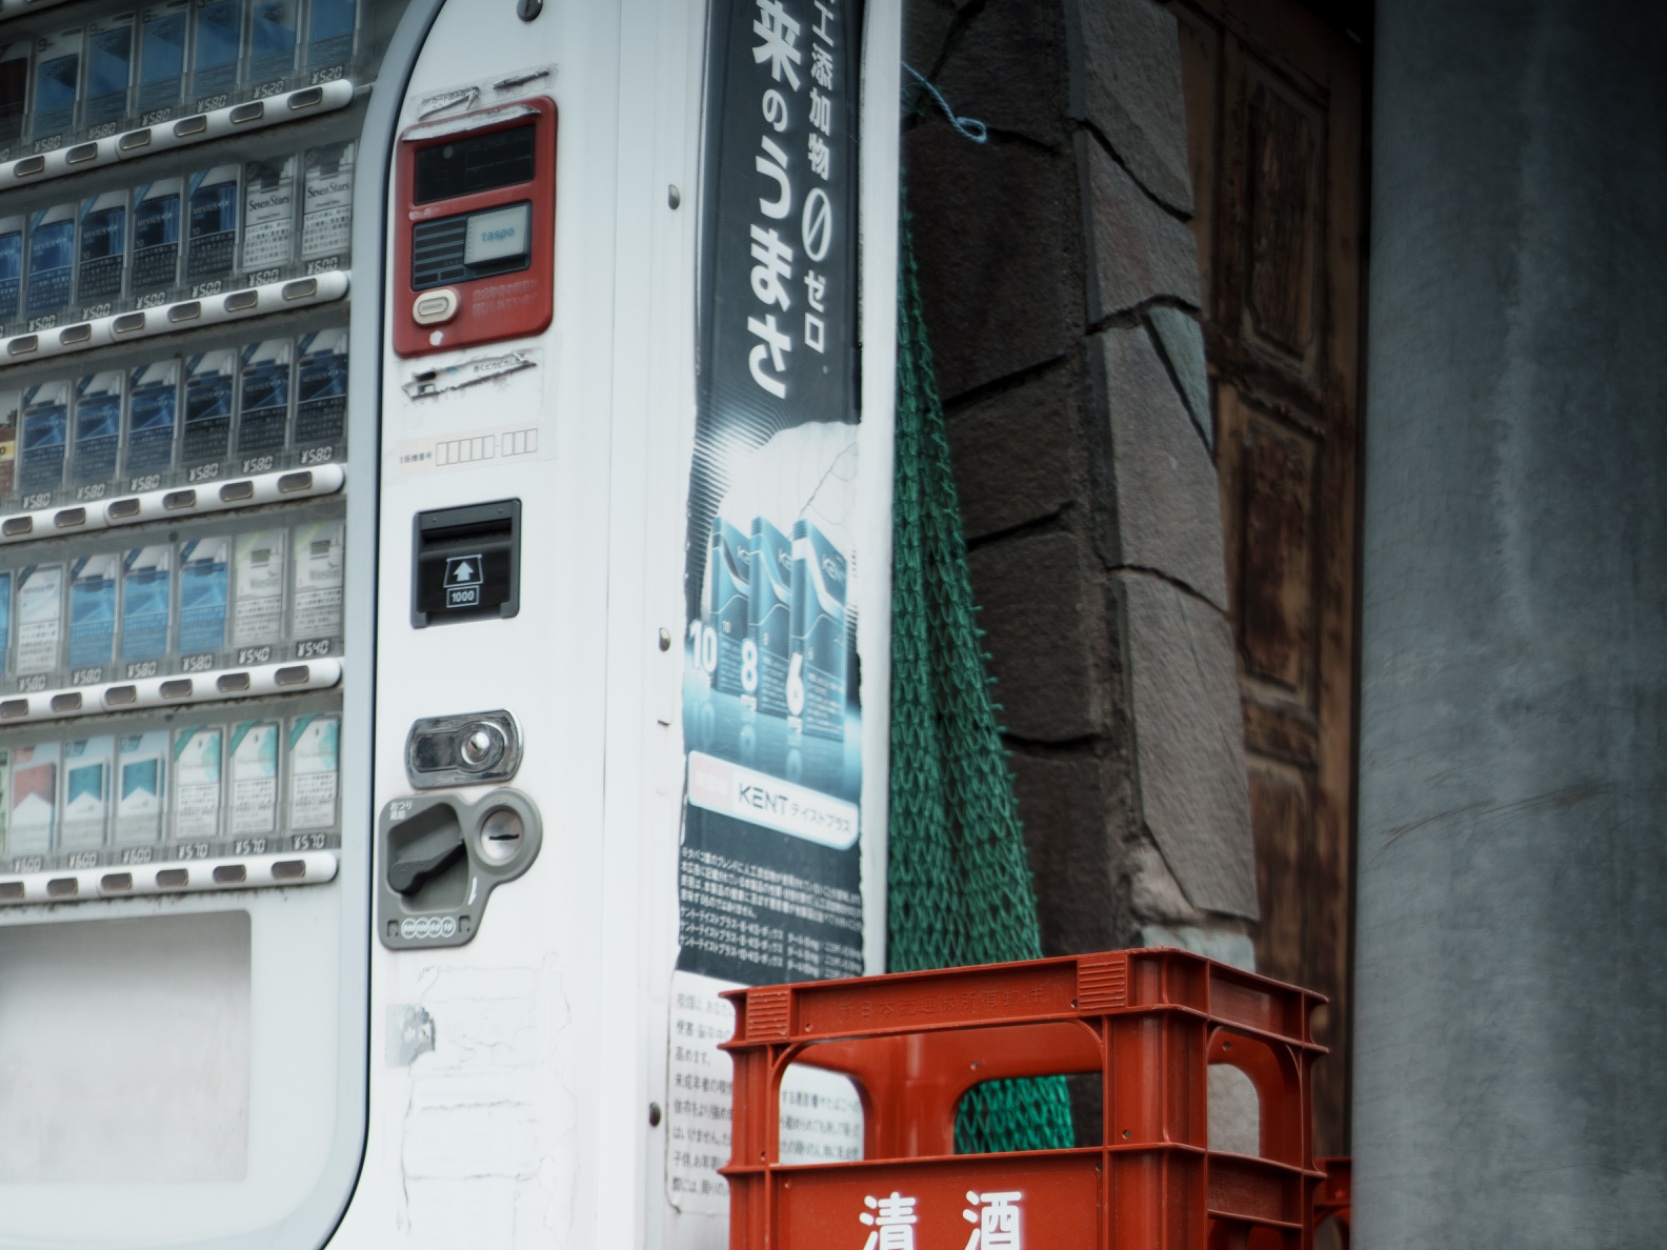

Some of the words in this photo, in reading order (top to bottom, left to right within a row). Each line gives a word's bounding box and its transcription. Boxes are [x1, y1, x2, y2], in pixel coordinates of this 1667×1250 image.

[807, 0, 834, 181] 工添加物
[481, 226, 515, 243] taspo
[191, 280, 222, 298] ¥500
[136, 292, 165, 309] ¥500
[82, 303, 111, 321] ¥500
[28, 315, 56, 332] ¥500
[243, 456, 273, 473] ¥580
[301, 447, 332, 464] ¥580
[451, 590, 475, 602] 1000
[689, 619, 718, 673] 10
[741, 638, 758, 692] 8
[786, 653, 805, 716] 6
[739, 782, 788, 816] KENT
